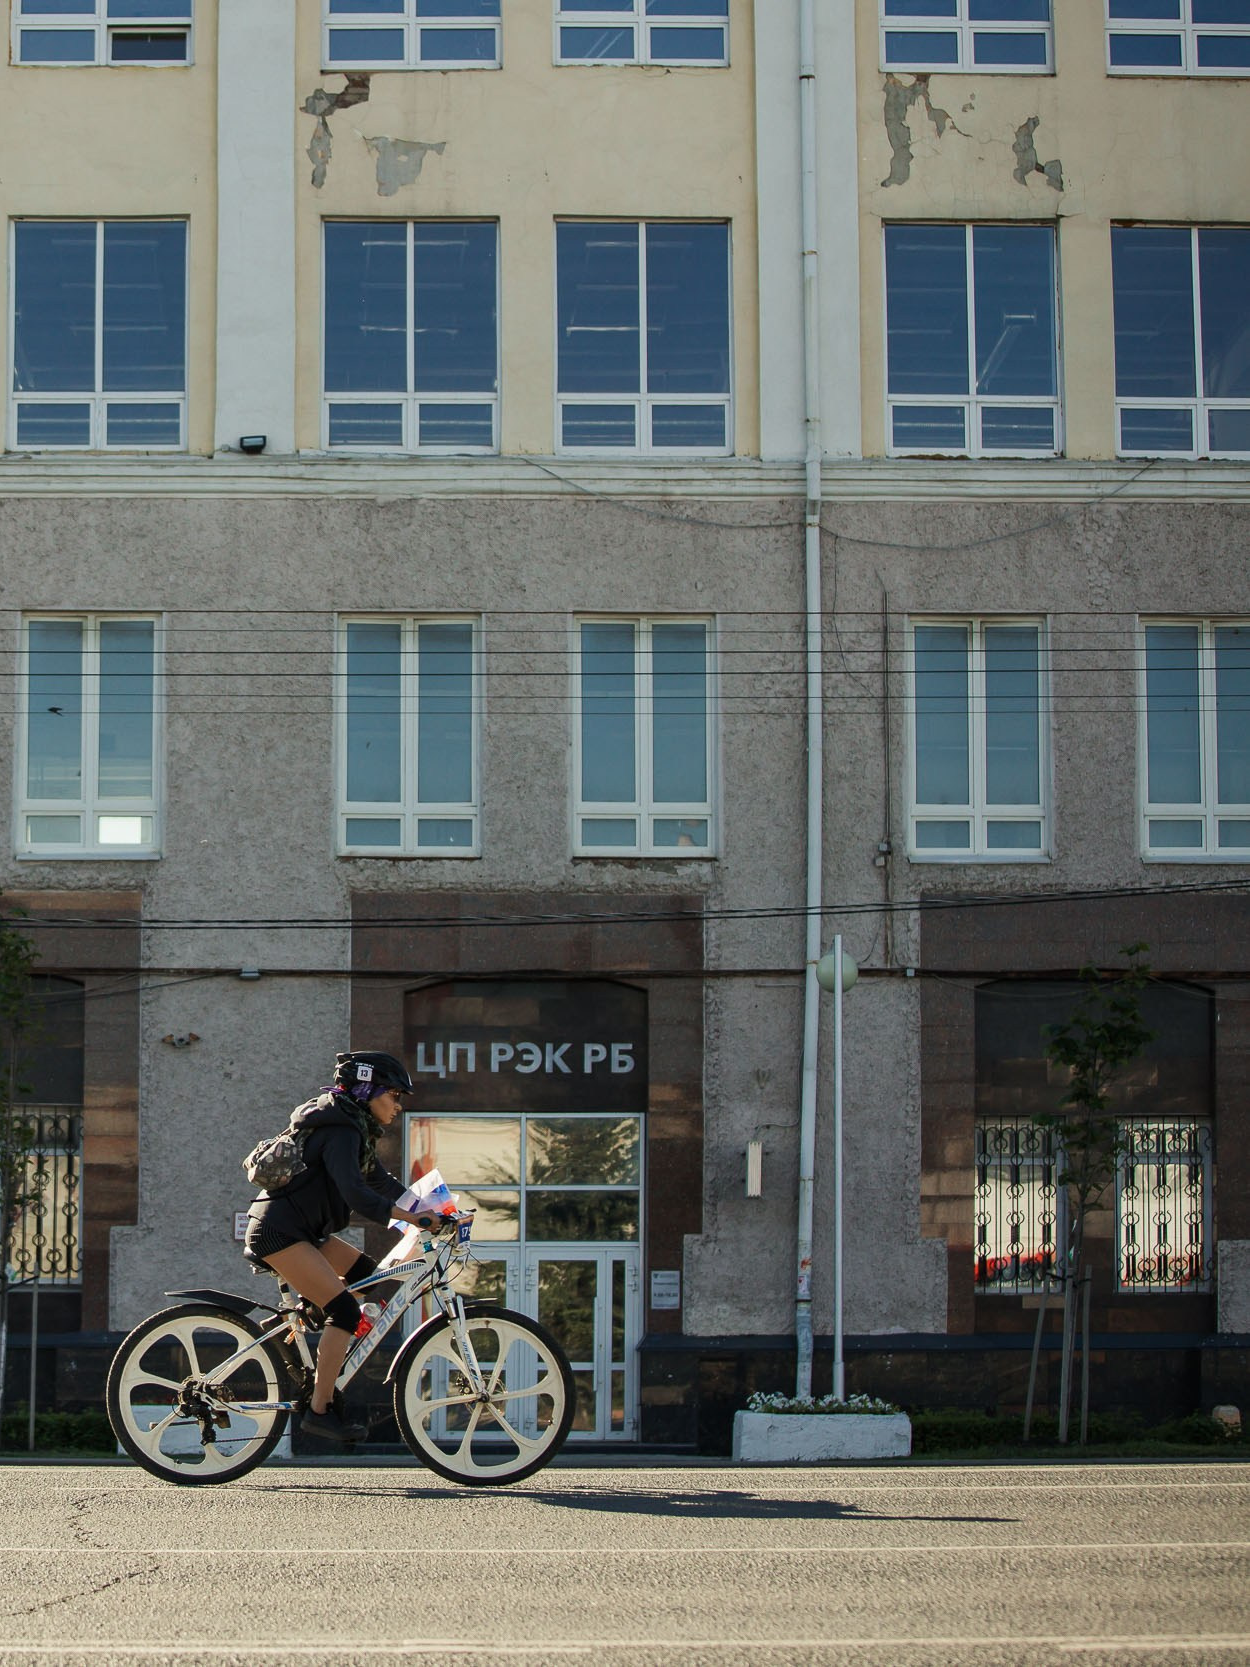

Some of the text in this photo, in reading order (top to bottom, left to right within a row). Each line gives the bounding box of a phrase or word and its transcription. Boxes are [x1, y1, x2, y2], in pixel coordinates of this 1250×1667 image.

[417, 1042, 635, 1079] ЦП РЭК РБ
[360, 1069, 369, 1078] 13
